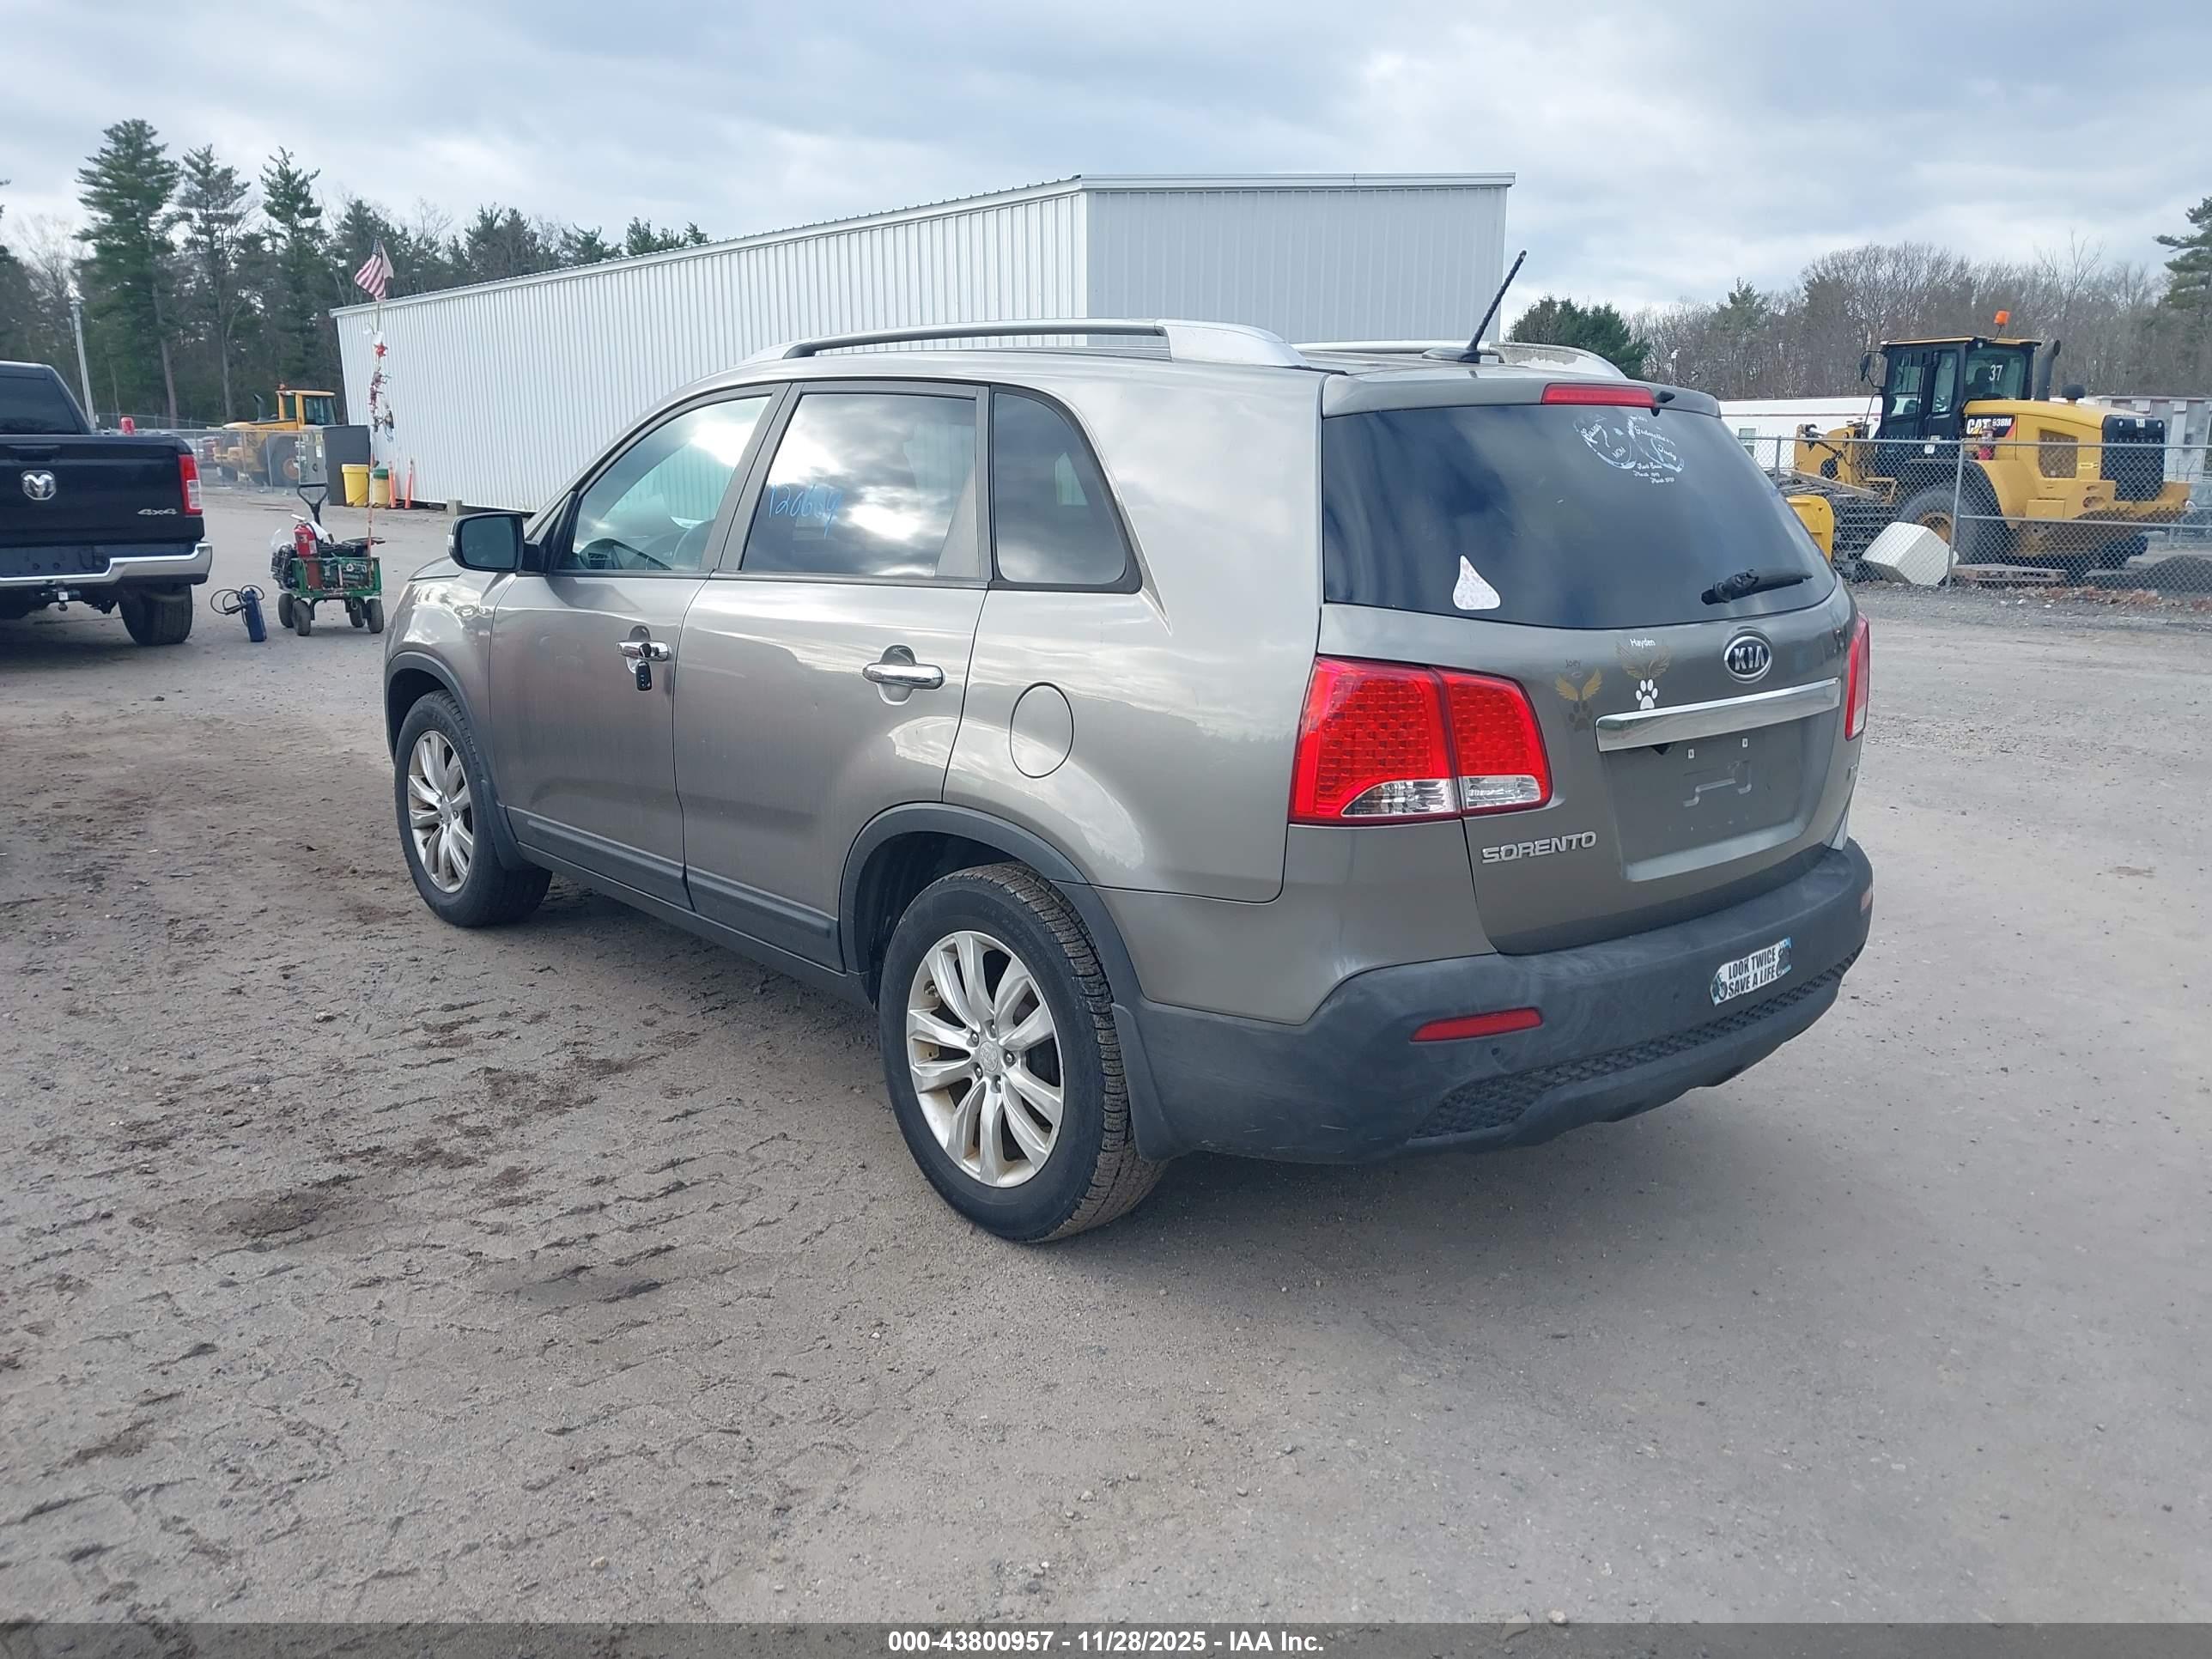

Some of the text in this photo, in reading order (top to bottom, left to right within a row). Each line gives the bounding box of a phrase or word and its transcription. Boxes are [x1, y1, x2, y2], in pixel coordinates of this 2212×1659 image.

[1989, 364, 2003, 381] 37
[1966, 418, 1991, 434] CAT
[137, 507, 178, 516] 4x4
[1629, 638, 1656, 648] Hayden
[1734, 645, 1765, 671] KIA
[1482, 830, 1597, 864] SORENTO
[1729, 947, 1776, 980] LOOK TWICE
[1729, 965, 1776, 997] SAVE A LIFE
